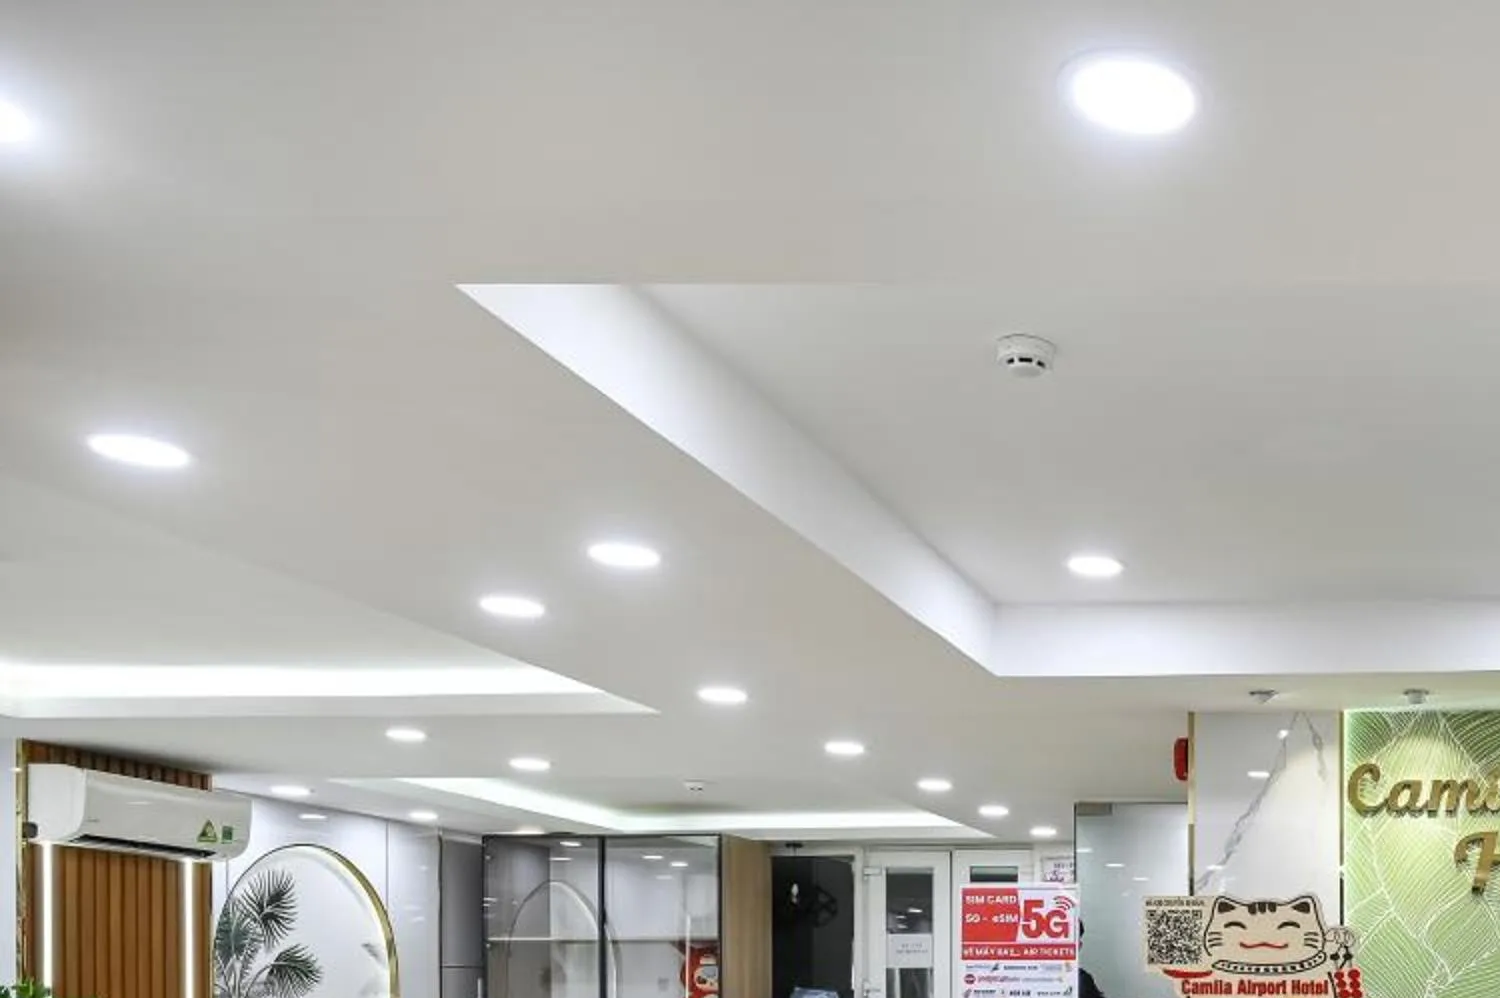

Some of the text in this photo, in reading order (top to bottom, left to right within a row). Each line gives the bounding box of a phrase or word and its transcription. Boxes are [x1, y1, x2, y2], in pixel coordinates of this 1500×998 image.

[965, 895, 1018, 905] SIM CARD
[1022, 899, 1070, 938] 5G
[1181, 979, 1329, 997] Camila Airport Hotel
